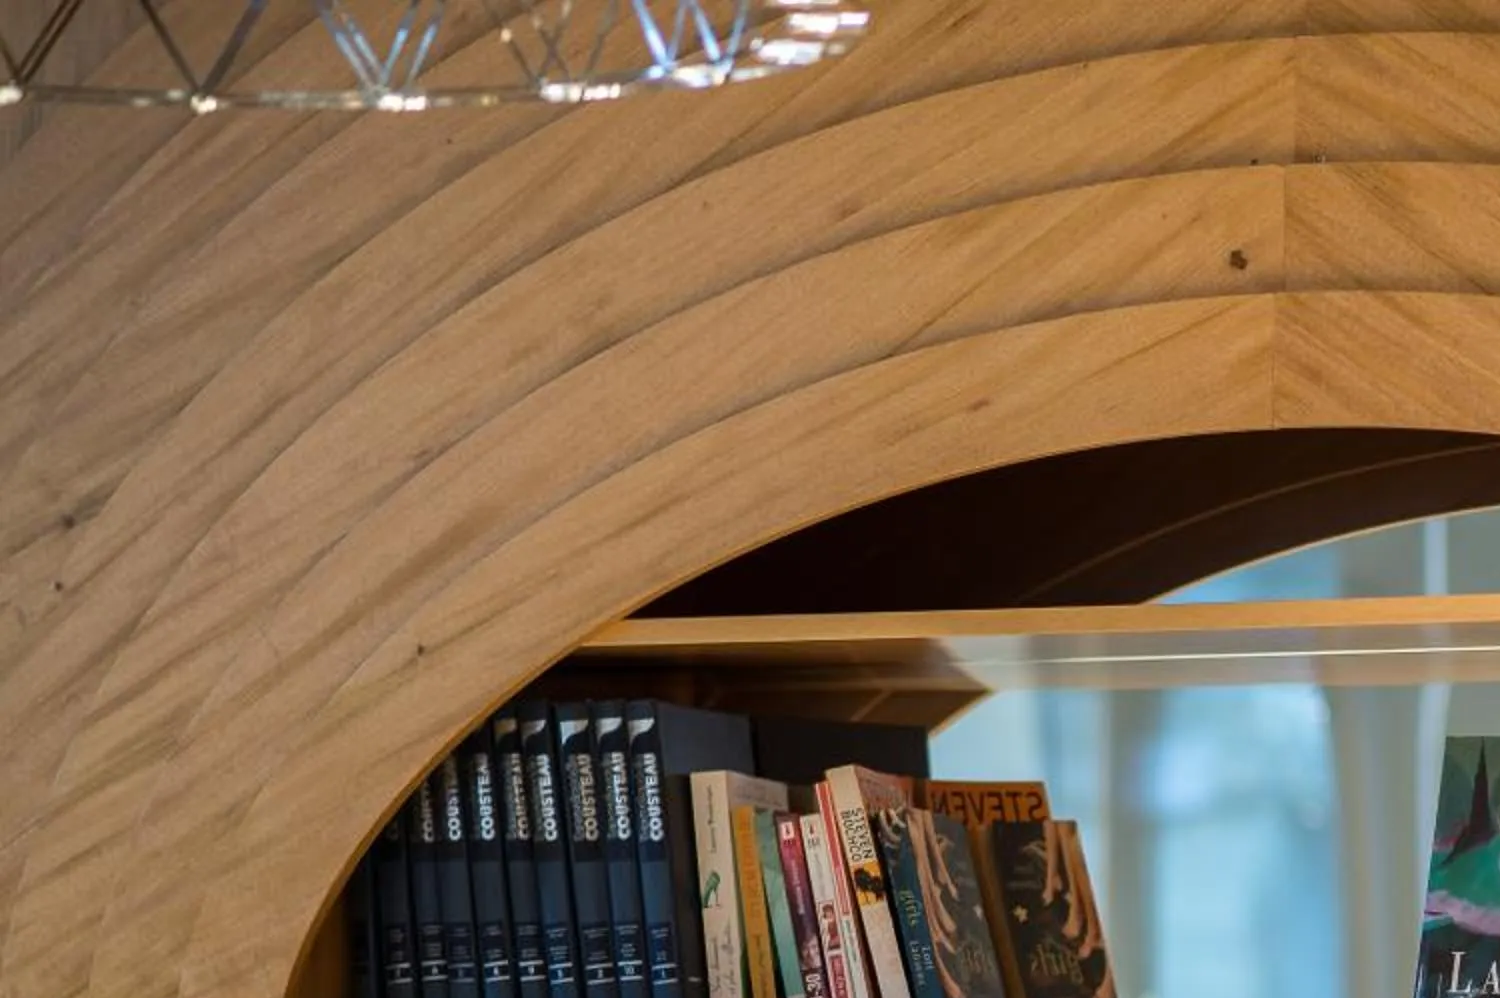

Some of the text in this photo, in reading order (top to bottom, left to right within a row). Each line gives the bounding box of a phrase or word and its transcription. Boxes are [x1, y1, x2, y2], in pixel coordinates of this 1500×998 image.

[536, 753, 557, 841] COUSTEAU
[576, 753, 598, 841] COUSTEAU
[611, 752, 631, 841] COUSTEAU
[644, 752, 664, 841] COUSTEAU
[852, 807, 874, 860] STEVEN
[1447, 952, 1500, 995] LA
